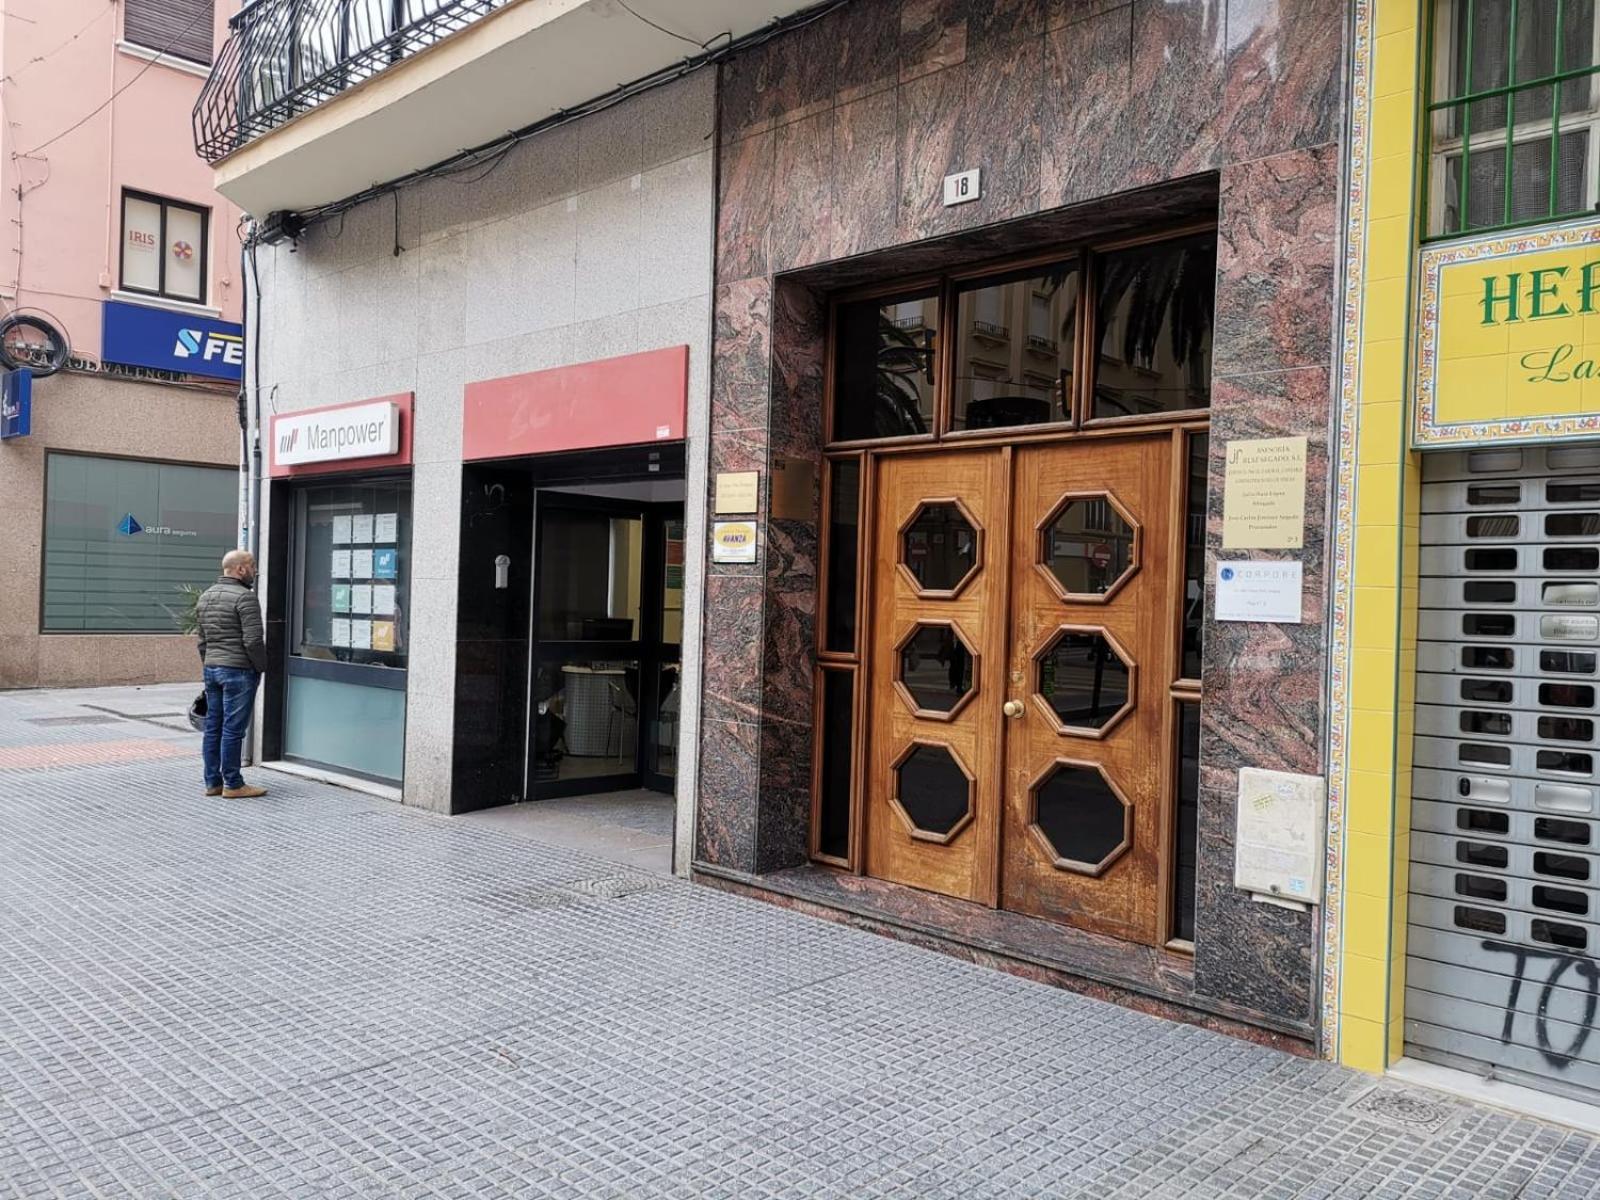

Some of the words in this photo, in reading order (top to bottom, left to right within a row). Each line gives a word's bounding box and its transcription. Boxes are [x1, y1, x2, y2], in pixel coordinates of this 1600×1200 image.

[953, 177, 969, 198] 18
[129, 230, 155, 246] IRIS
[1520, 343, 1600, 382] La
[307, 421, 385, 453] Manpower
[145, 526, 171, 535] aura
